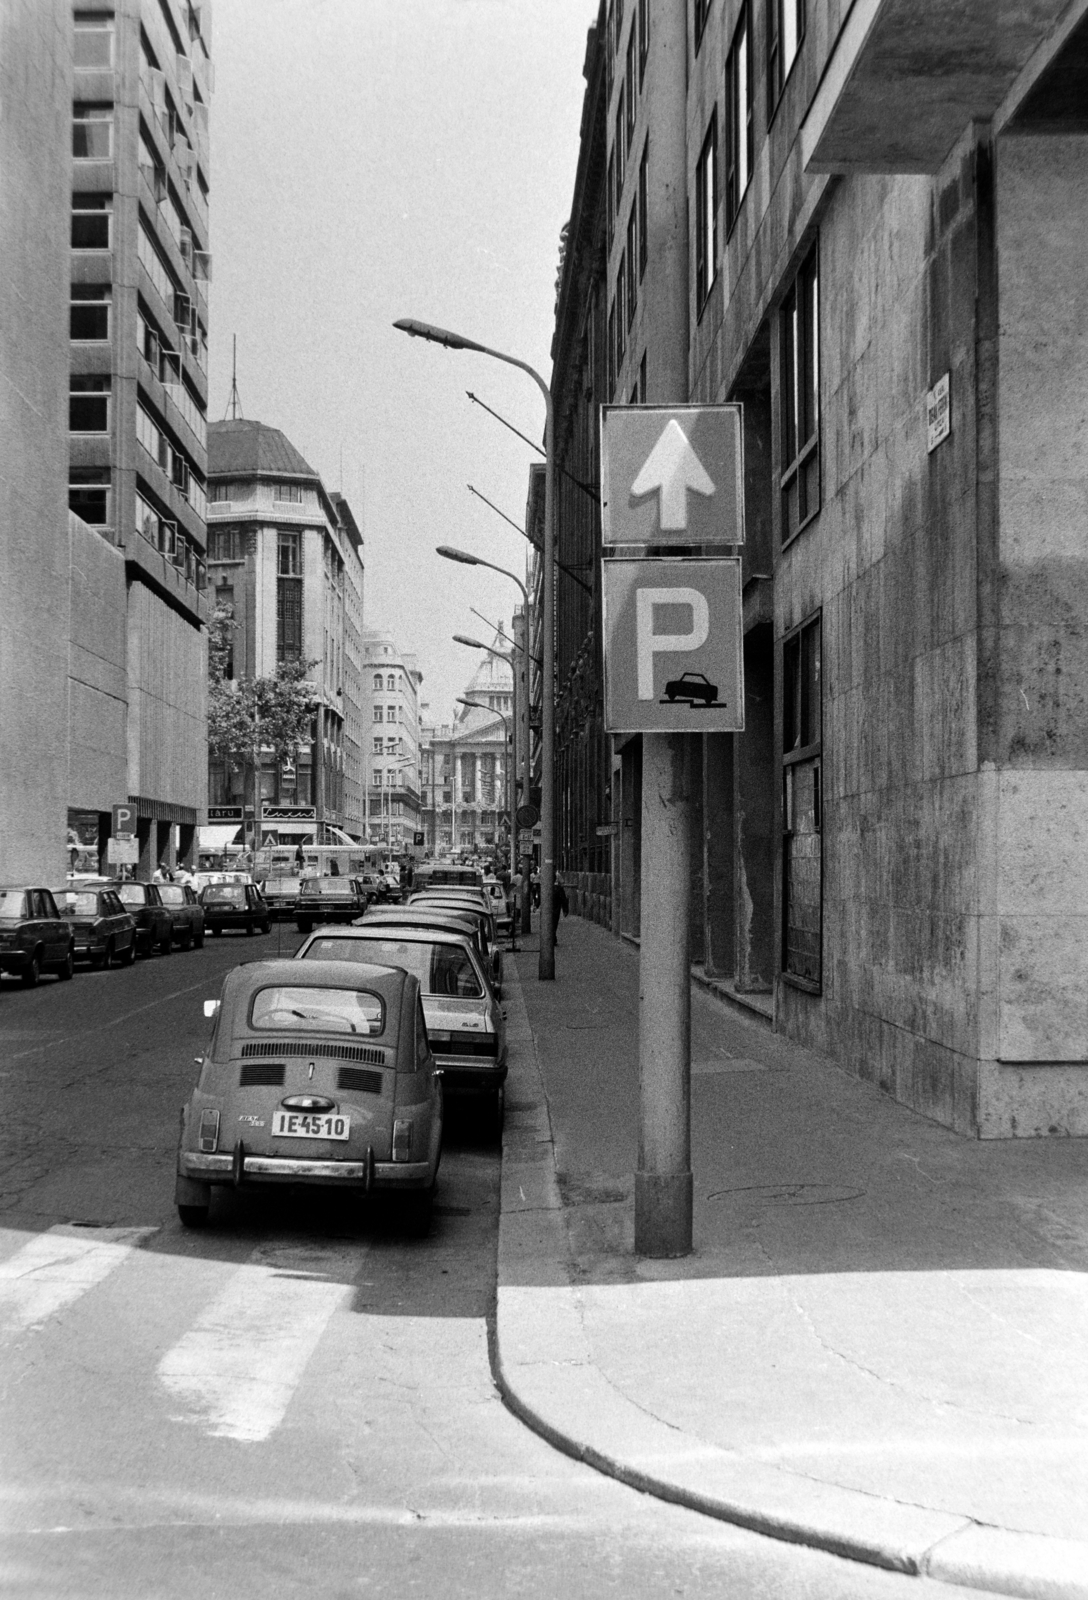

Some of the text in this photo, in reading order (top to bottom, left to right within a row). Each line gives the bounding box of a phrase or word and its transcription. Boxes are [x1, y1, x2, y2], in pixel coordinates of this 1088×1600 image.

[636, 587, 710, 701] P
[117, 808, 131, 830] P
[263, 808, 315, 818] Luxus
[415, 834, 422, 844] P
